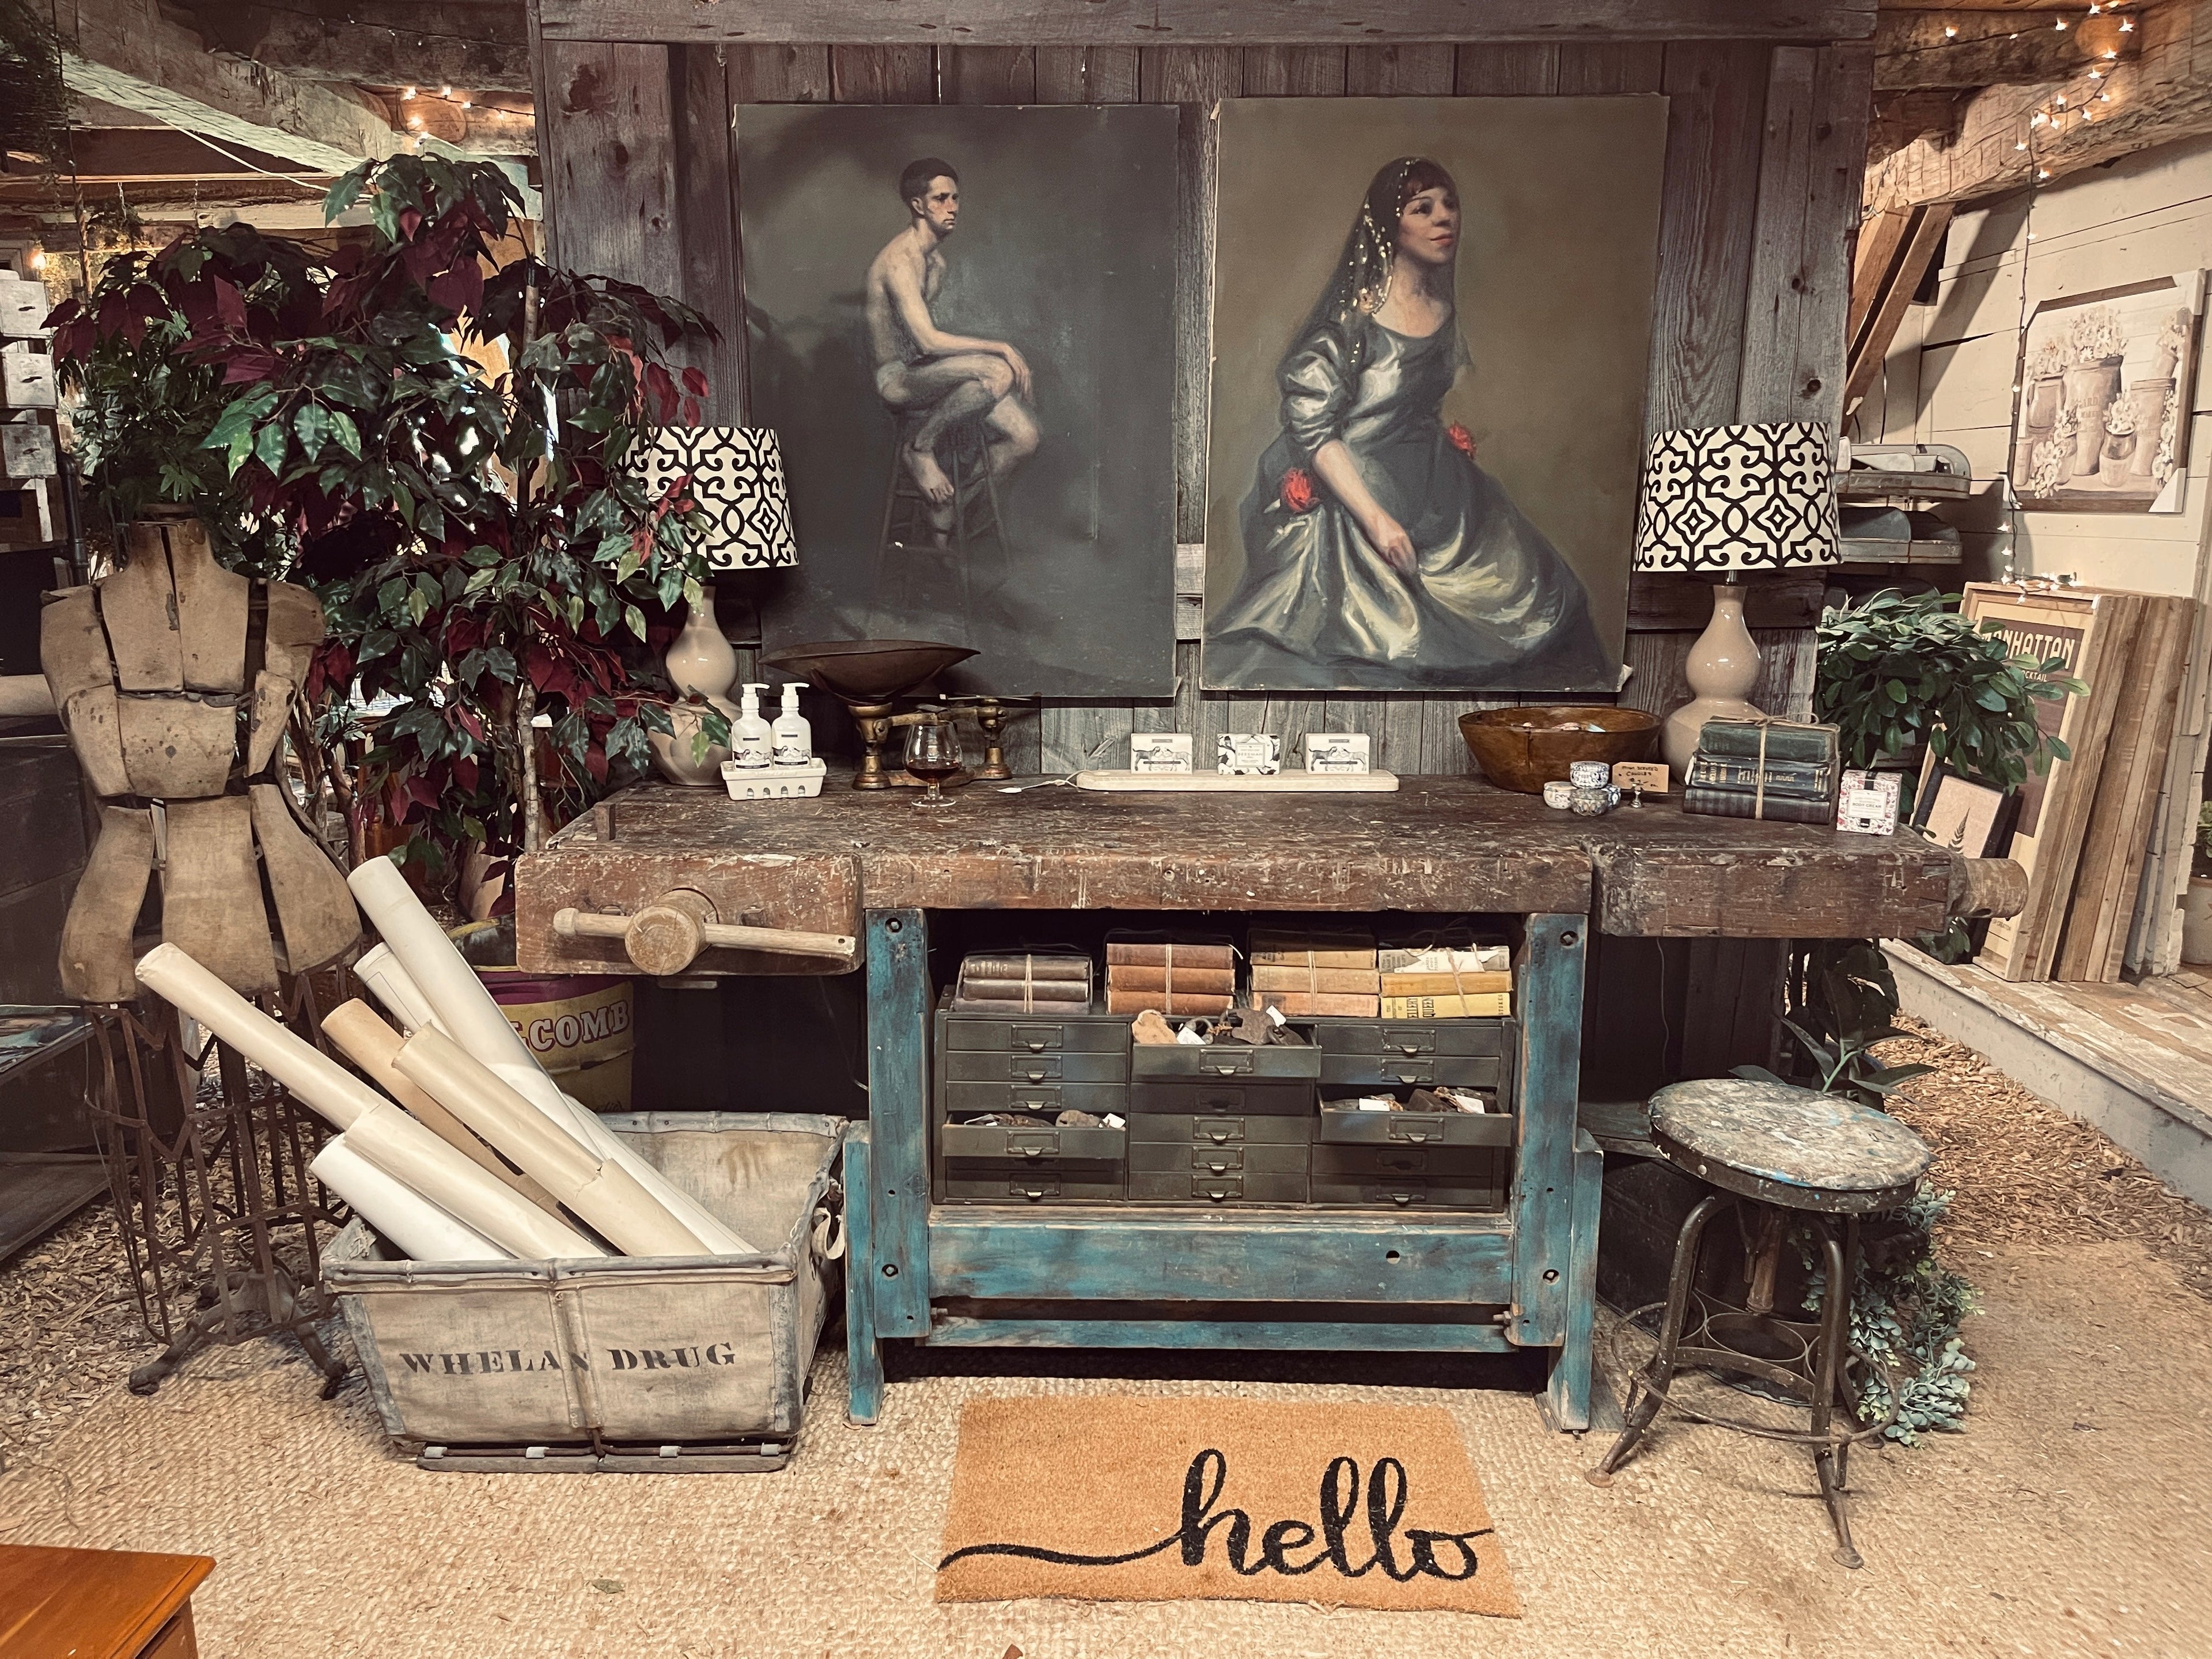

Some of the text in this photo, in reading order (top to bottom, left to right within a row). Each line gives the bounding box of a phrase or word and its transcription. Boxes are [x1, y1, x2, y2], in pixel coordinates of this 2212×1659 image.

[1422, 997, 1436, 1018] QUEEN
[399, 1342, 736, 1375] WHELAN DRUG
[1129, 1448, 1494, 1582] hello
